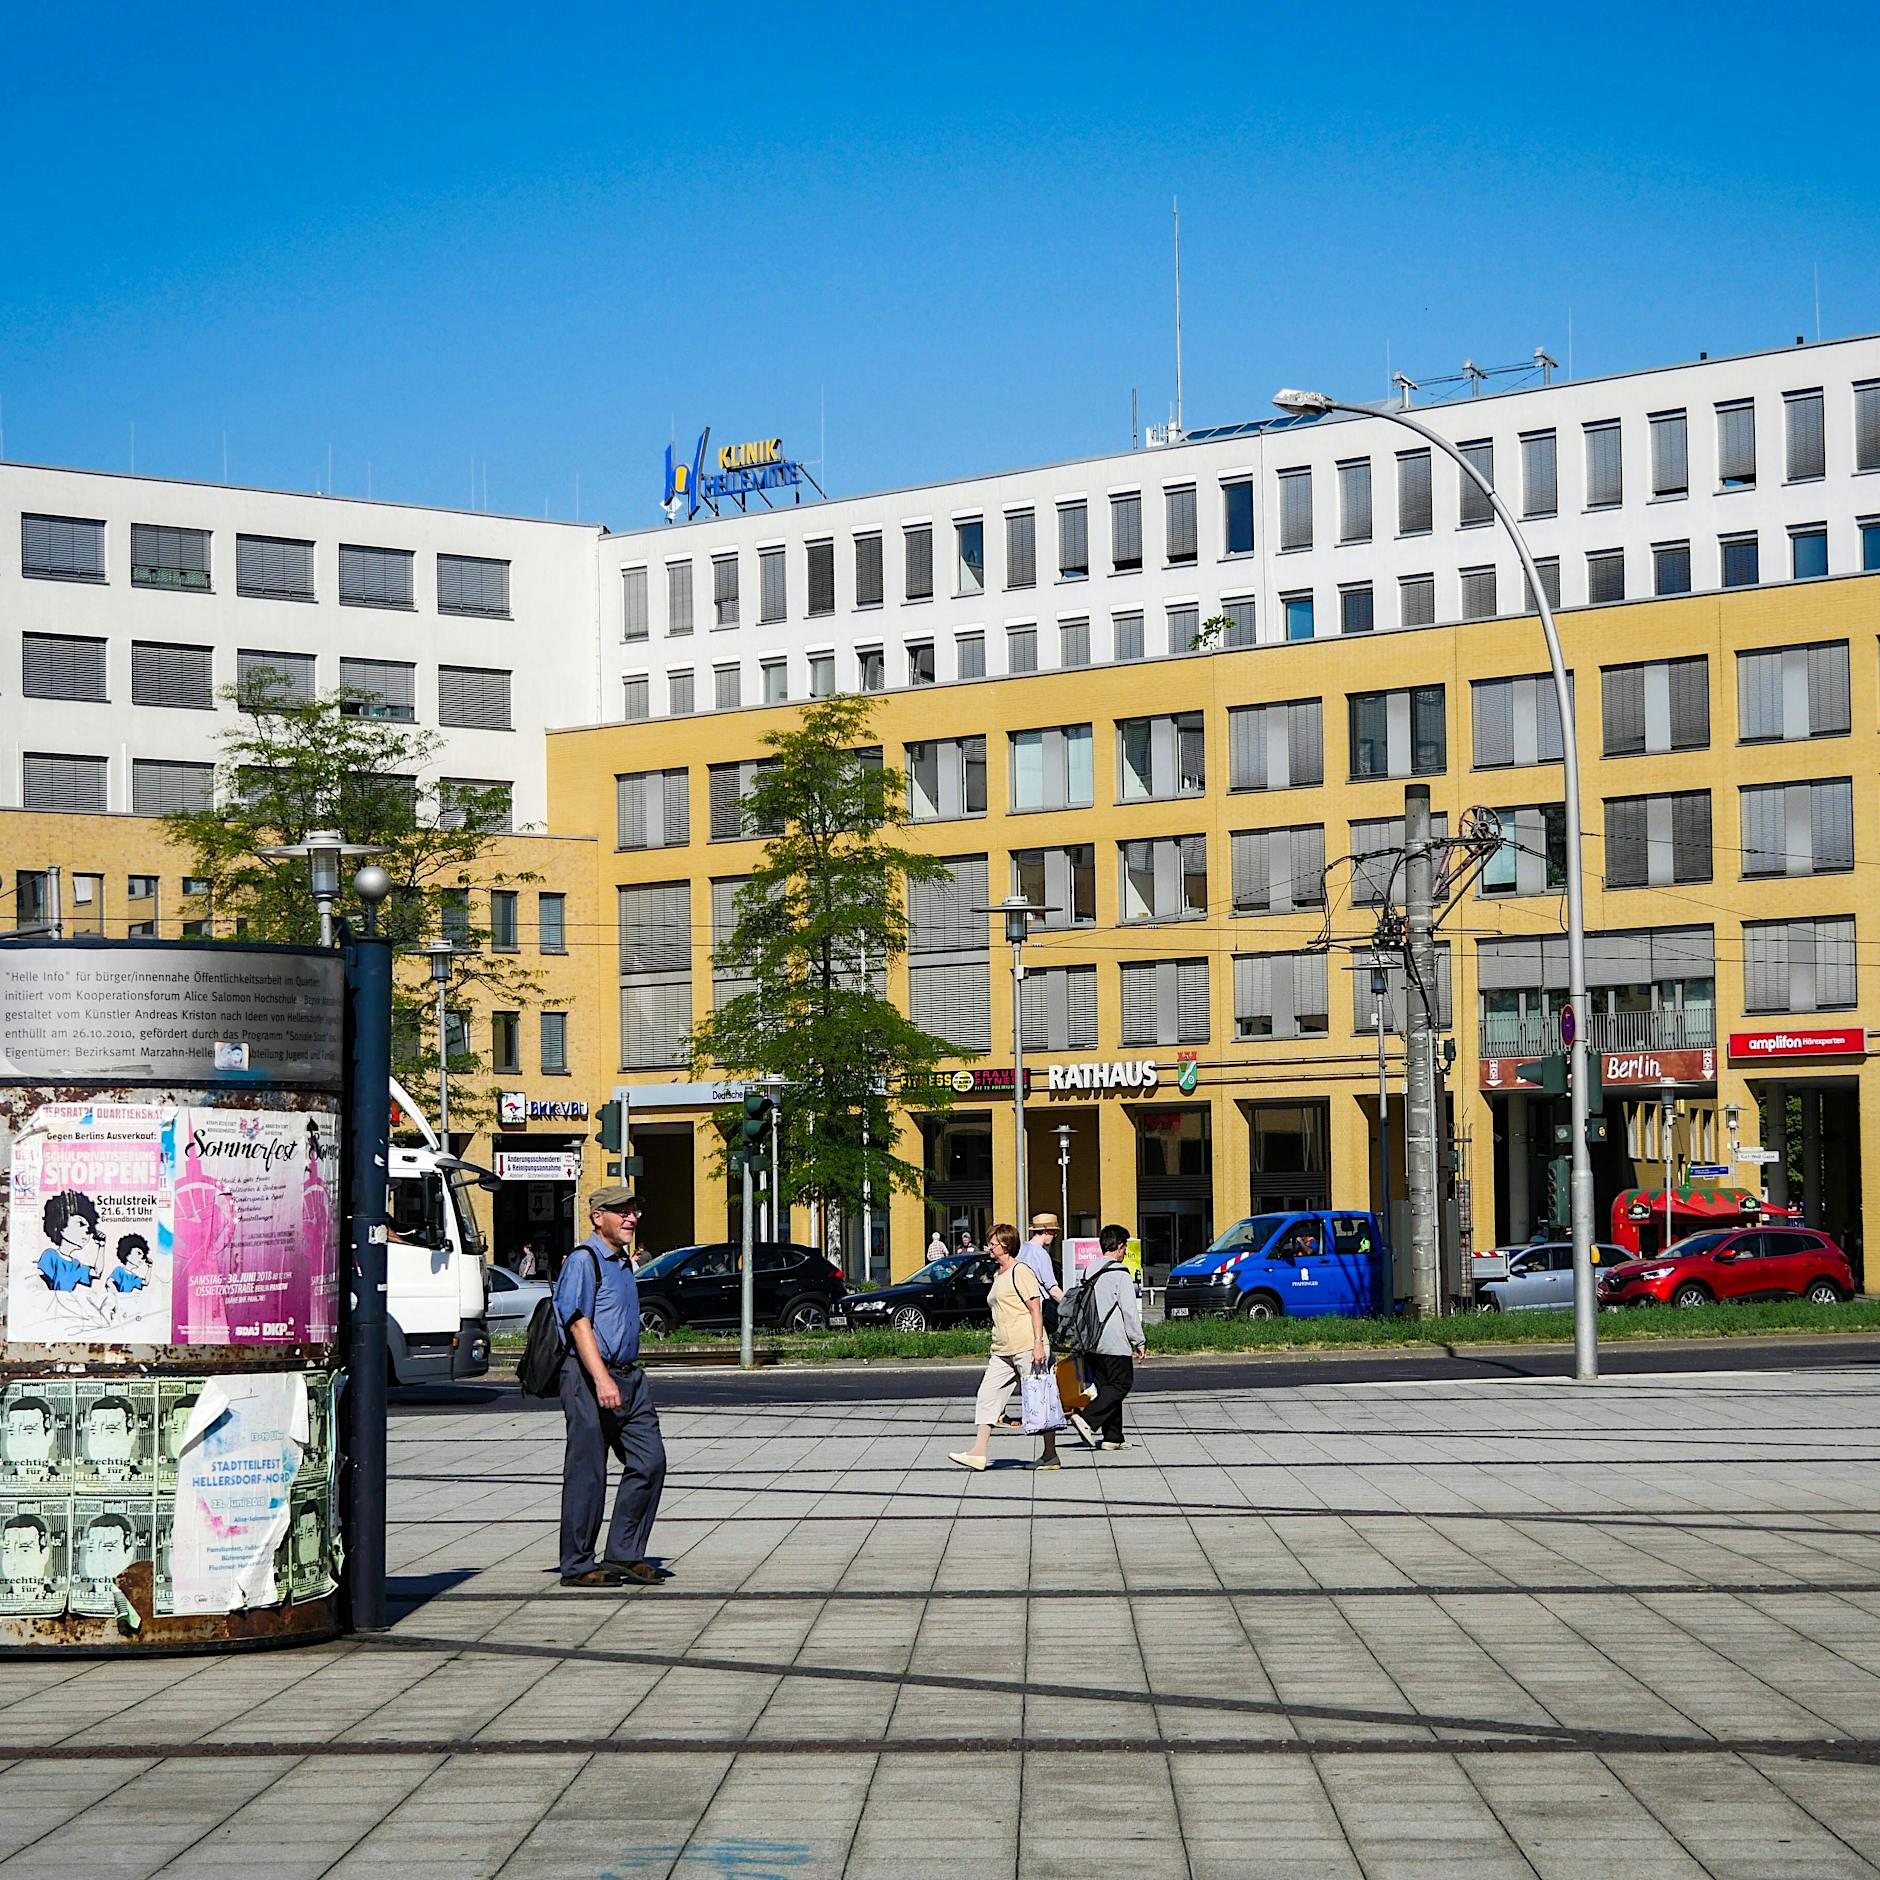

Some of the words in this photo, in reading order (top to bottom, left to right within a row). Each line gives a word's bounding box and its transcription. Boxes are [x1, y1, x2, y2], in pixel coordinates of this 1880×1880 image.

[718, 438, 782, 469] KLINIK
[76, 971, 91, 981] für
[95, 971, 190, 984] bürger/innennahe
[194, 970, 282, 985] Öffentlichkeitsarbeit
[5, 990, 43, 1001] initiiert
[48, 992, 71, 1001] vom
[76, 990, 180, 1003] Kooperationsforum
[184, 991, 208, 1002] Alice
[211, 991, 251, 1003] Salomon
[254, 993, 297, 1005] Hochschule
[5, 1009, 52, 1021] gestaltet
[57, 1011, 80, 1019] vom
[85, 1009, 131, 1020] Künstler
[134, 1009, 178, 1020] Andreas
[182, 1010, 217, 1020] Kriston
[220, 1011, 242, 1021] nach
[245, 1011, 268, 1021] Ideen
[271, 1013, 285, 1022] von
[5, 1027, 46, 1039] enthüllt
[51, 1030, 68, 1038] am
[72, 1029, 135, 1040] 26.10.2010,
[140, 1028, 188, 1040] gefördert
[192, 1028, 219, 1039] durch
[223, 1029, 239, 1040] das
[242, 1029, 283, 1042] Programm
[1748, 1035, 1802, 1052] amplifon
[1802, 1037, 1845, 1046] Hörexperten
[5, 1047, 70, 1059] Eigentümer:
[75, 1046, 136, 1057] Bezirksamt
[1048, 1060, 1157, 1091] RATHAUS
[1606, 1056, 1661, 1080] Berlin
[46, 1132, 73, 1142] Gegen
[75, 1131, 105, 1140] Berlins
[107, 1131, 157, 1140] Ausverkauf:
[185, 1129, 298, 1172] Sommerfest
[45, 1161, 156, 1185] STOPPEN!
[97, 1194, 157, 1206] Schulstreik
[126, 1207, 136, 1215] 11
[137, 1207, 153, 1215] Uhr
[189, 1274, 223, 1286] SAMSTAG
[228, 1273, 240, 1284] 30.
[240, 1271, 256, 1283] JUNI
[256, 1270, 272, 1282] 2018
[0, 1458, 71, 1468] erechtigkeit
[107, 1465, 123, 1474] für
[211, 1459, 281, 1472] STADTTEILFEST
[26, 1467, 42, 1475] für
[192, 1472, 290, 1488] HELLERSDORF-NORD
[0, 1576, 67, 1584] erechtigkeit
